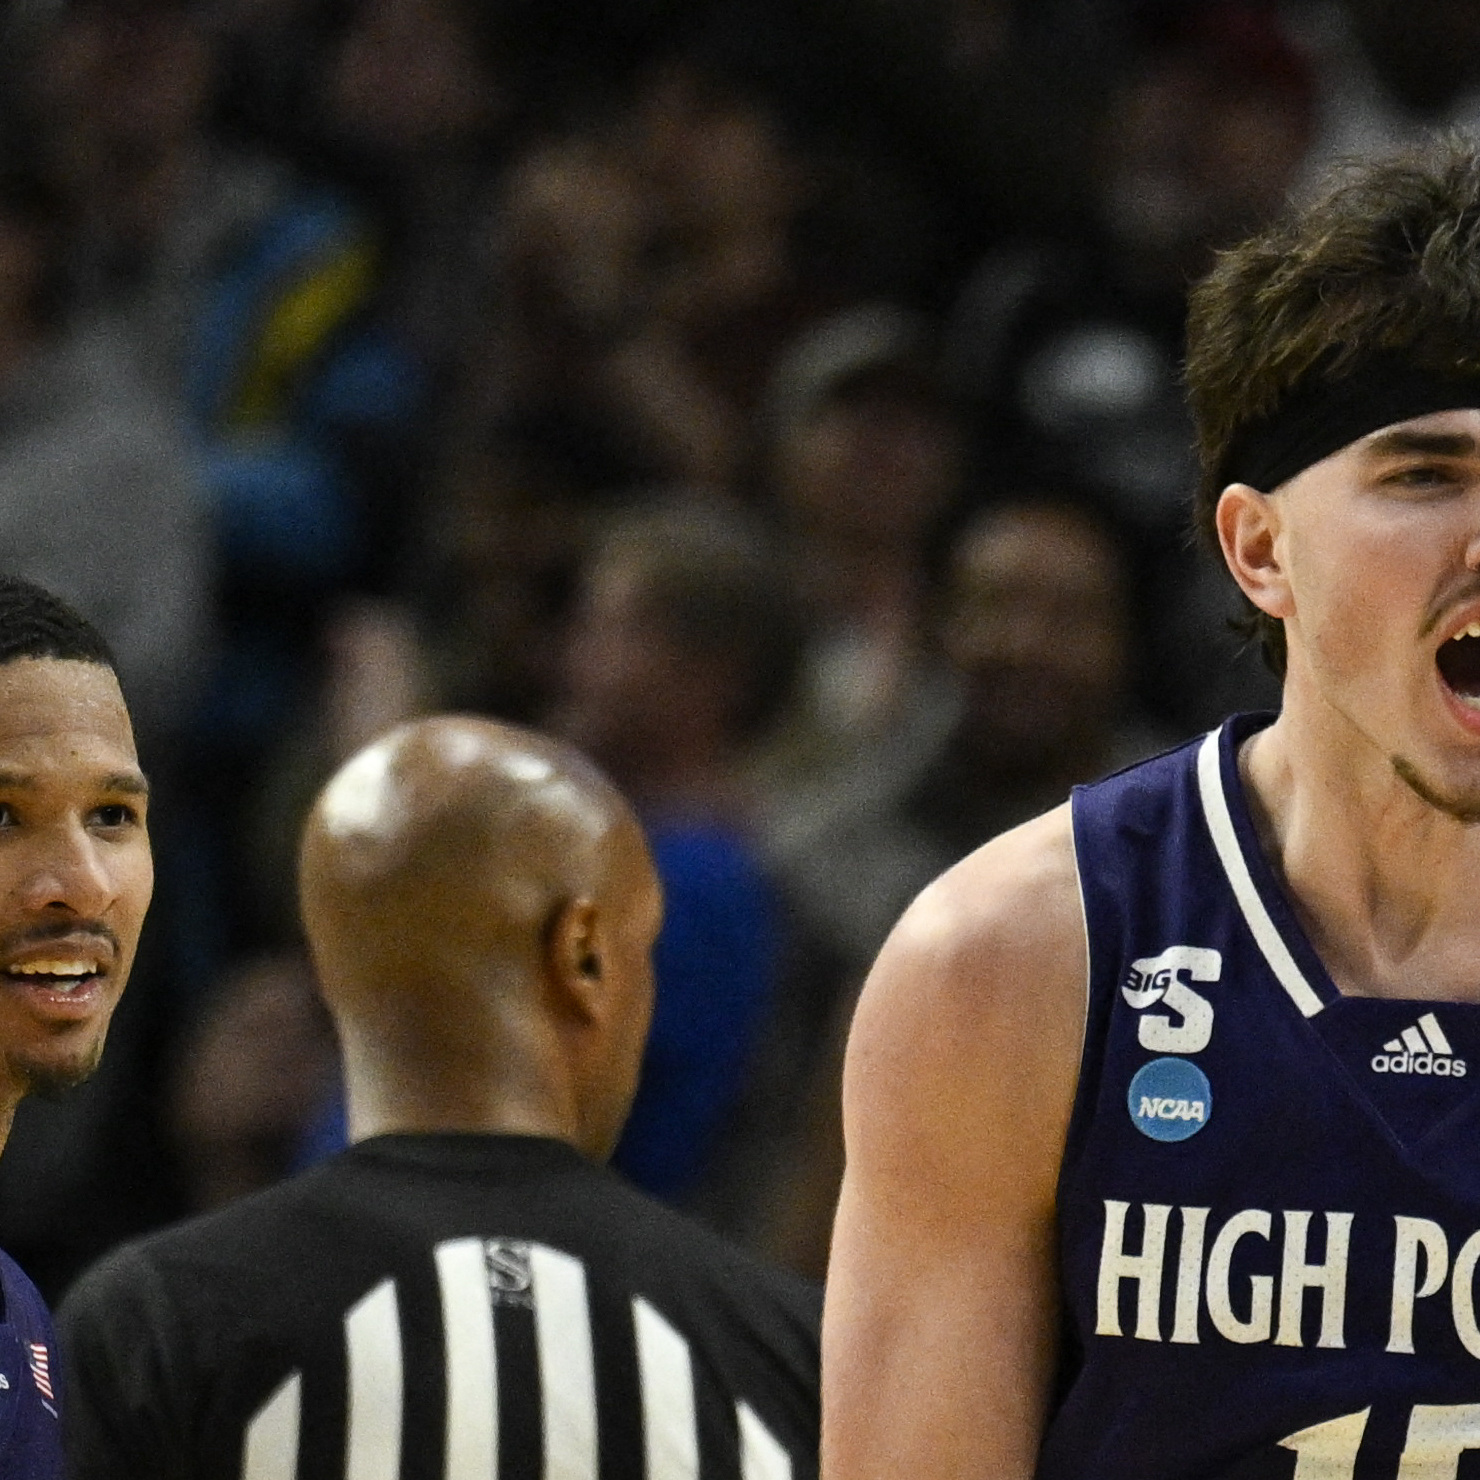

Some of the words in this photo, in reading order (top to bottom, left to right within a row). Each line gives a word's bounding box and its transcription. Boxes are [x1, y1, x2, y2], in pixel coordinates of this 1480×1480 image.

[1125, 967, 1171, 993] BIG
[1371, 1050, 1467, 1077] adidas
[1137, 1096, 1205, 1123] NCAA
[1094, 1199, 1355, 1349] HIGH
